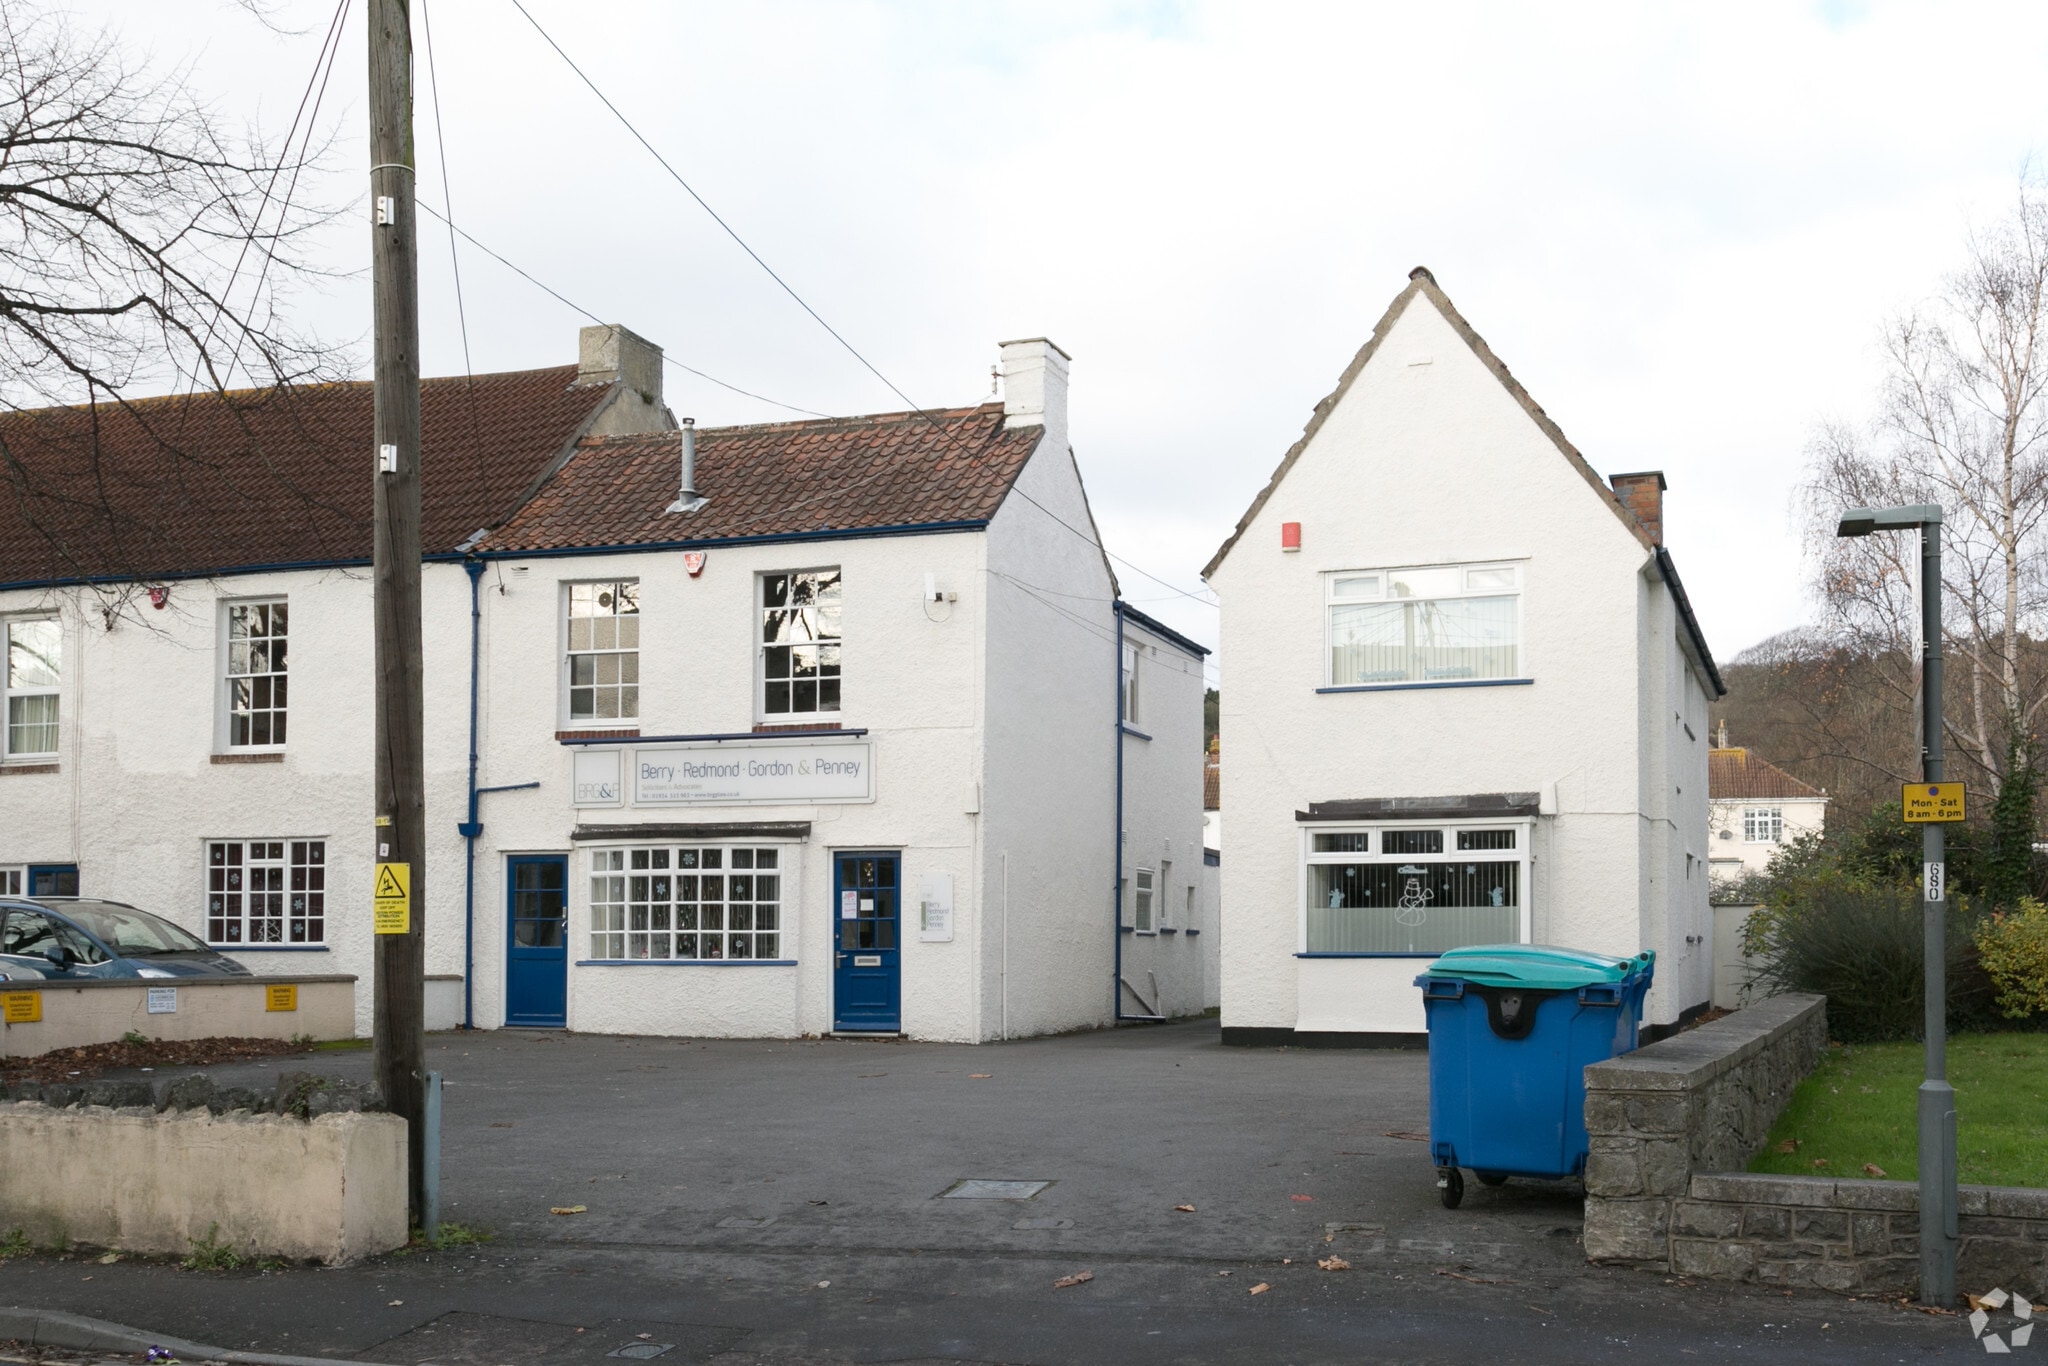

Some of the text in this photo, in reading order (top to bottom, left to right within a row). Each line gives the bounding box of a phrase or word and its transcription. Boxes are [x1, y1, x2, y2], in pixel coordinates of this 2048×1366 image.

[641, 758, 861, 782] Berry Redmond Gordon & Penney
[1940, 798, 1958, 807] Sat
[1907, 810, 1914, 818] 8
[1938, 809, 1945, 817] 6
[1946, 810, 1962, 819] pm
